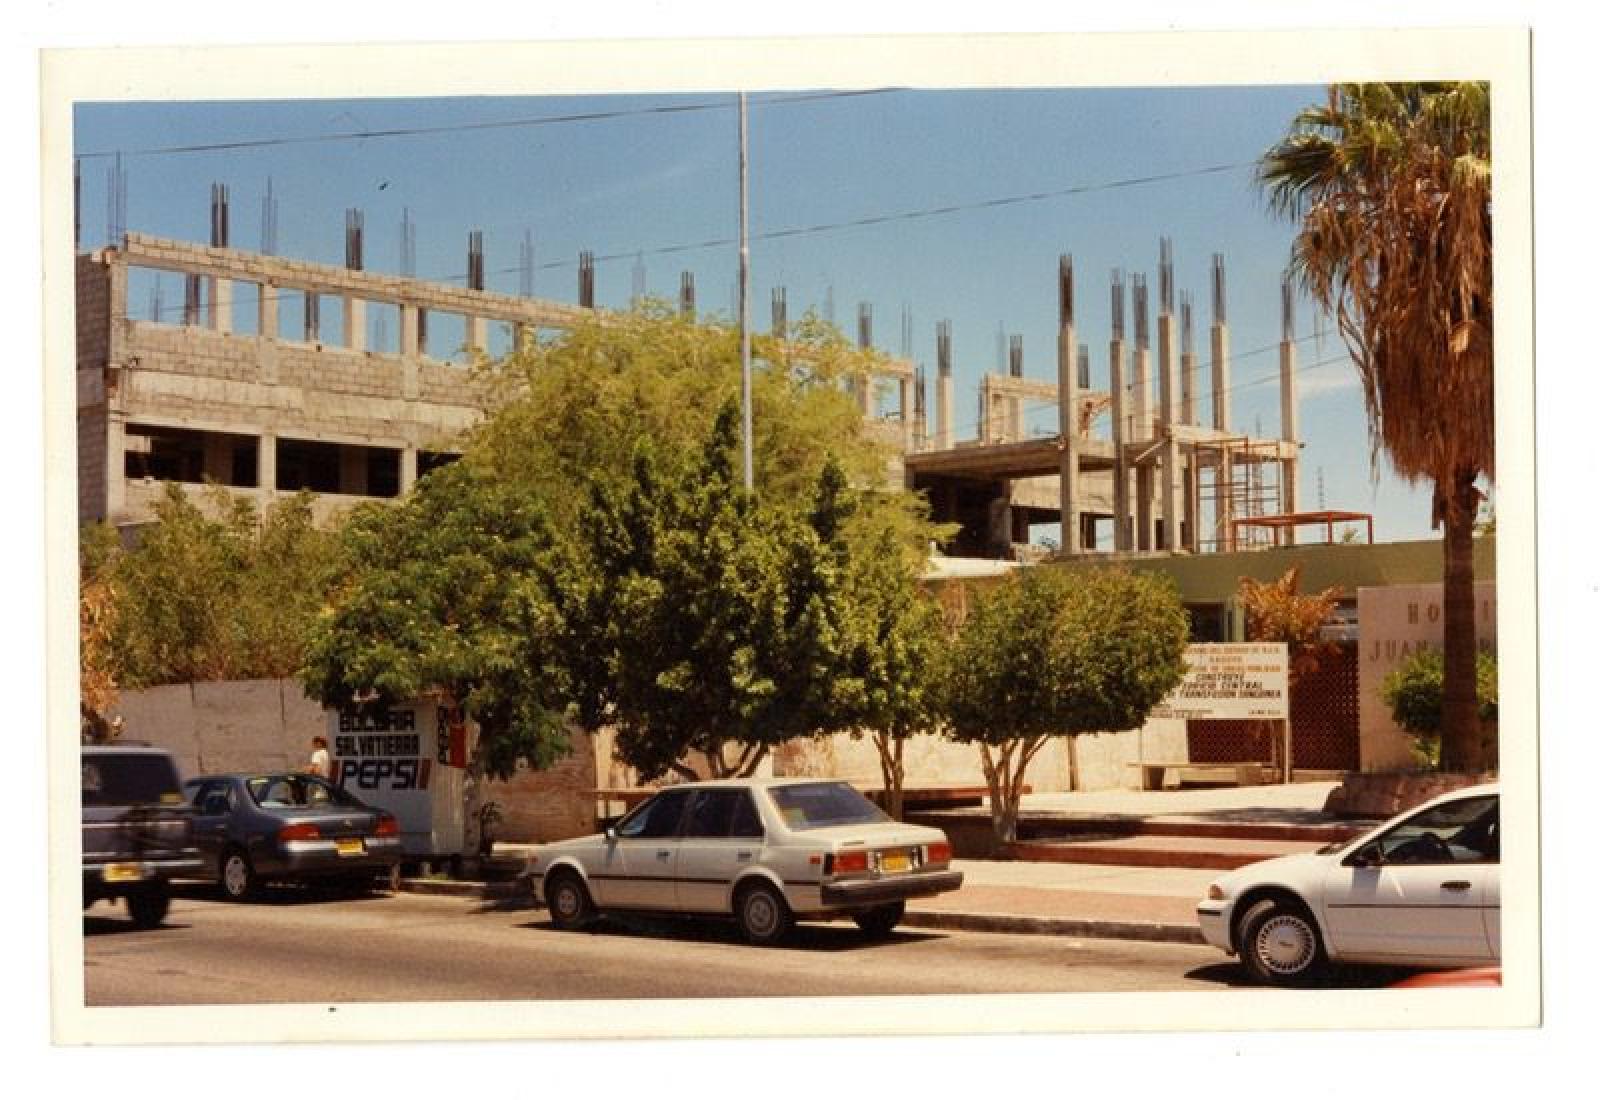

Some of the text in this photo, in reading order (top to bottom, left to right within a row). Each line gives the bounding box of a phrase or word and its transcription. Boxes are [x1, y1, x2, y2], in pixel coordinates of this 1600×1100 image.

[1221, 681, 1263, 689] CENTRAL
[335, 735, 419, 756] SALVATIERRA
[340, 758, 418, 790] PEPSI
